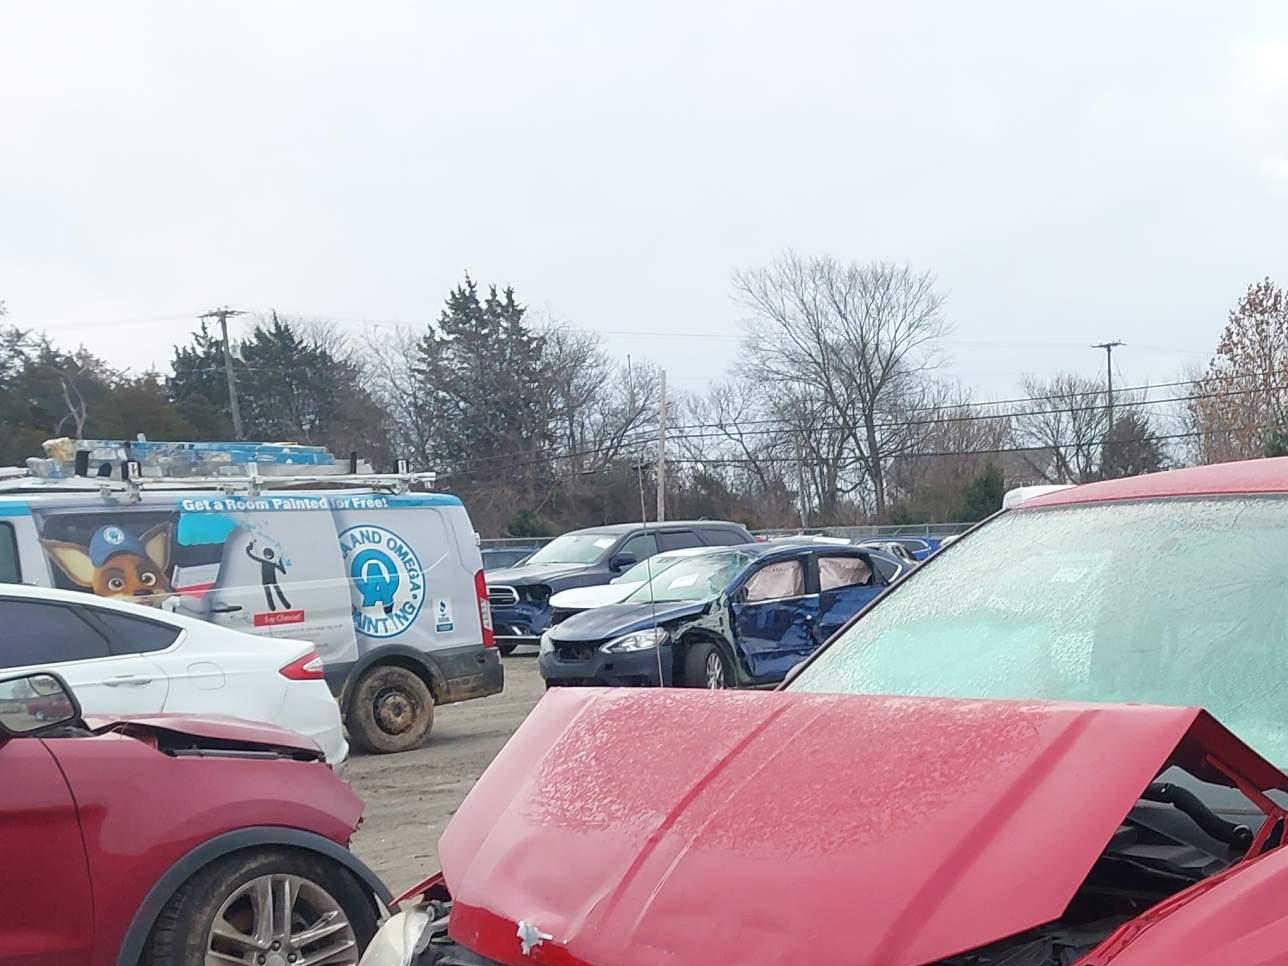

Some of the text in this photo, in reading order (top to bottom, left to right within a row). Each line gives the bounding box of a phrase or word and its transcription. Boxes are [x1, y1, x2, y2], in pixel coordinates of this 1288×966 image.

[182, 499, 211, 512] Get
[214, 501, 224, 511] a
[226, 498, 270, 511] Room
[272, 497, 328, 510] Painted
[352, 496, 389, 509] Free!
[350, 530, 421, 633] AND OMEGA AINTING
